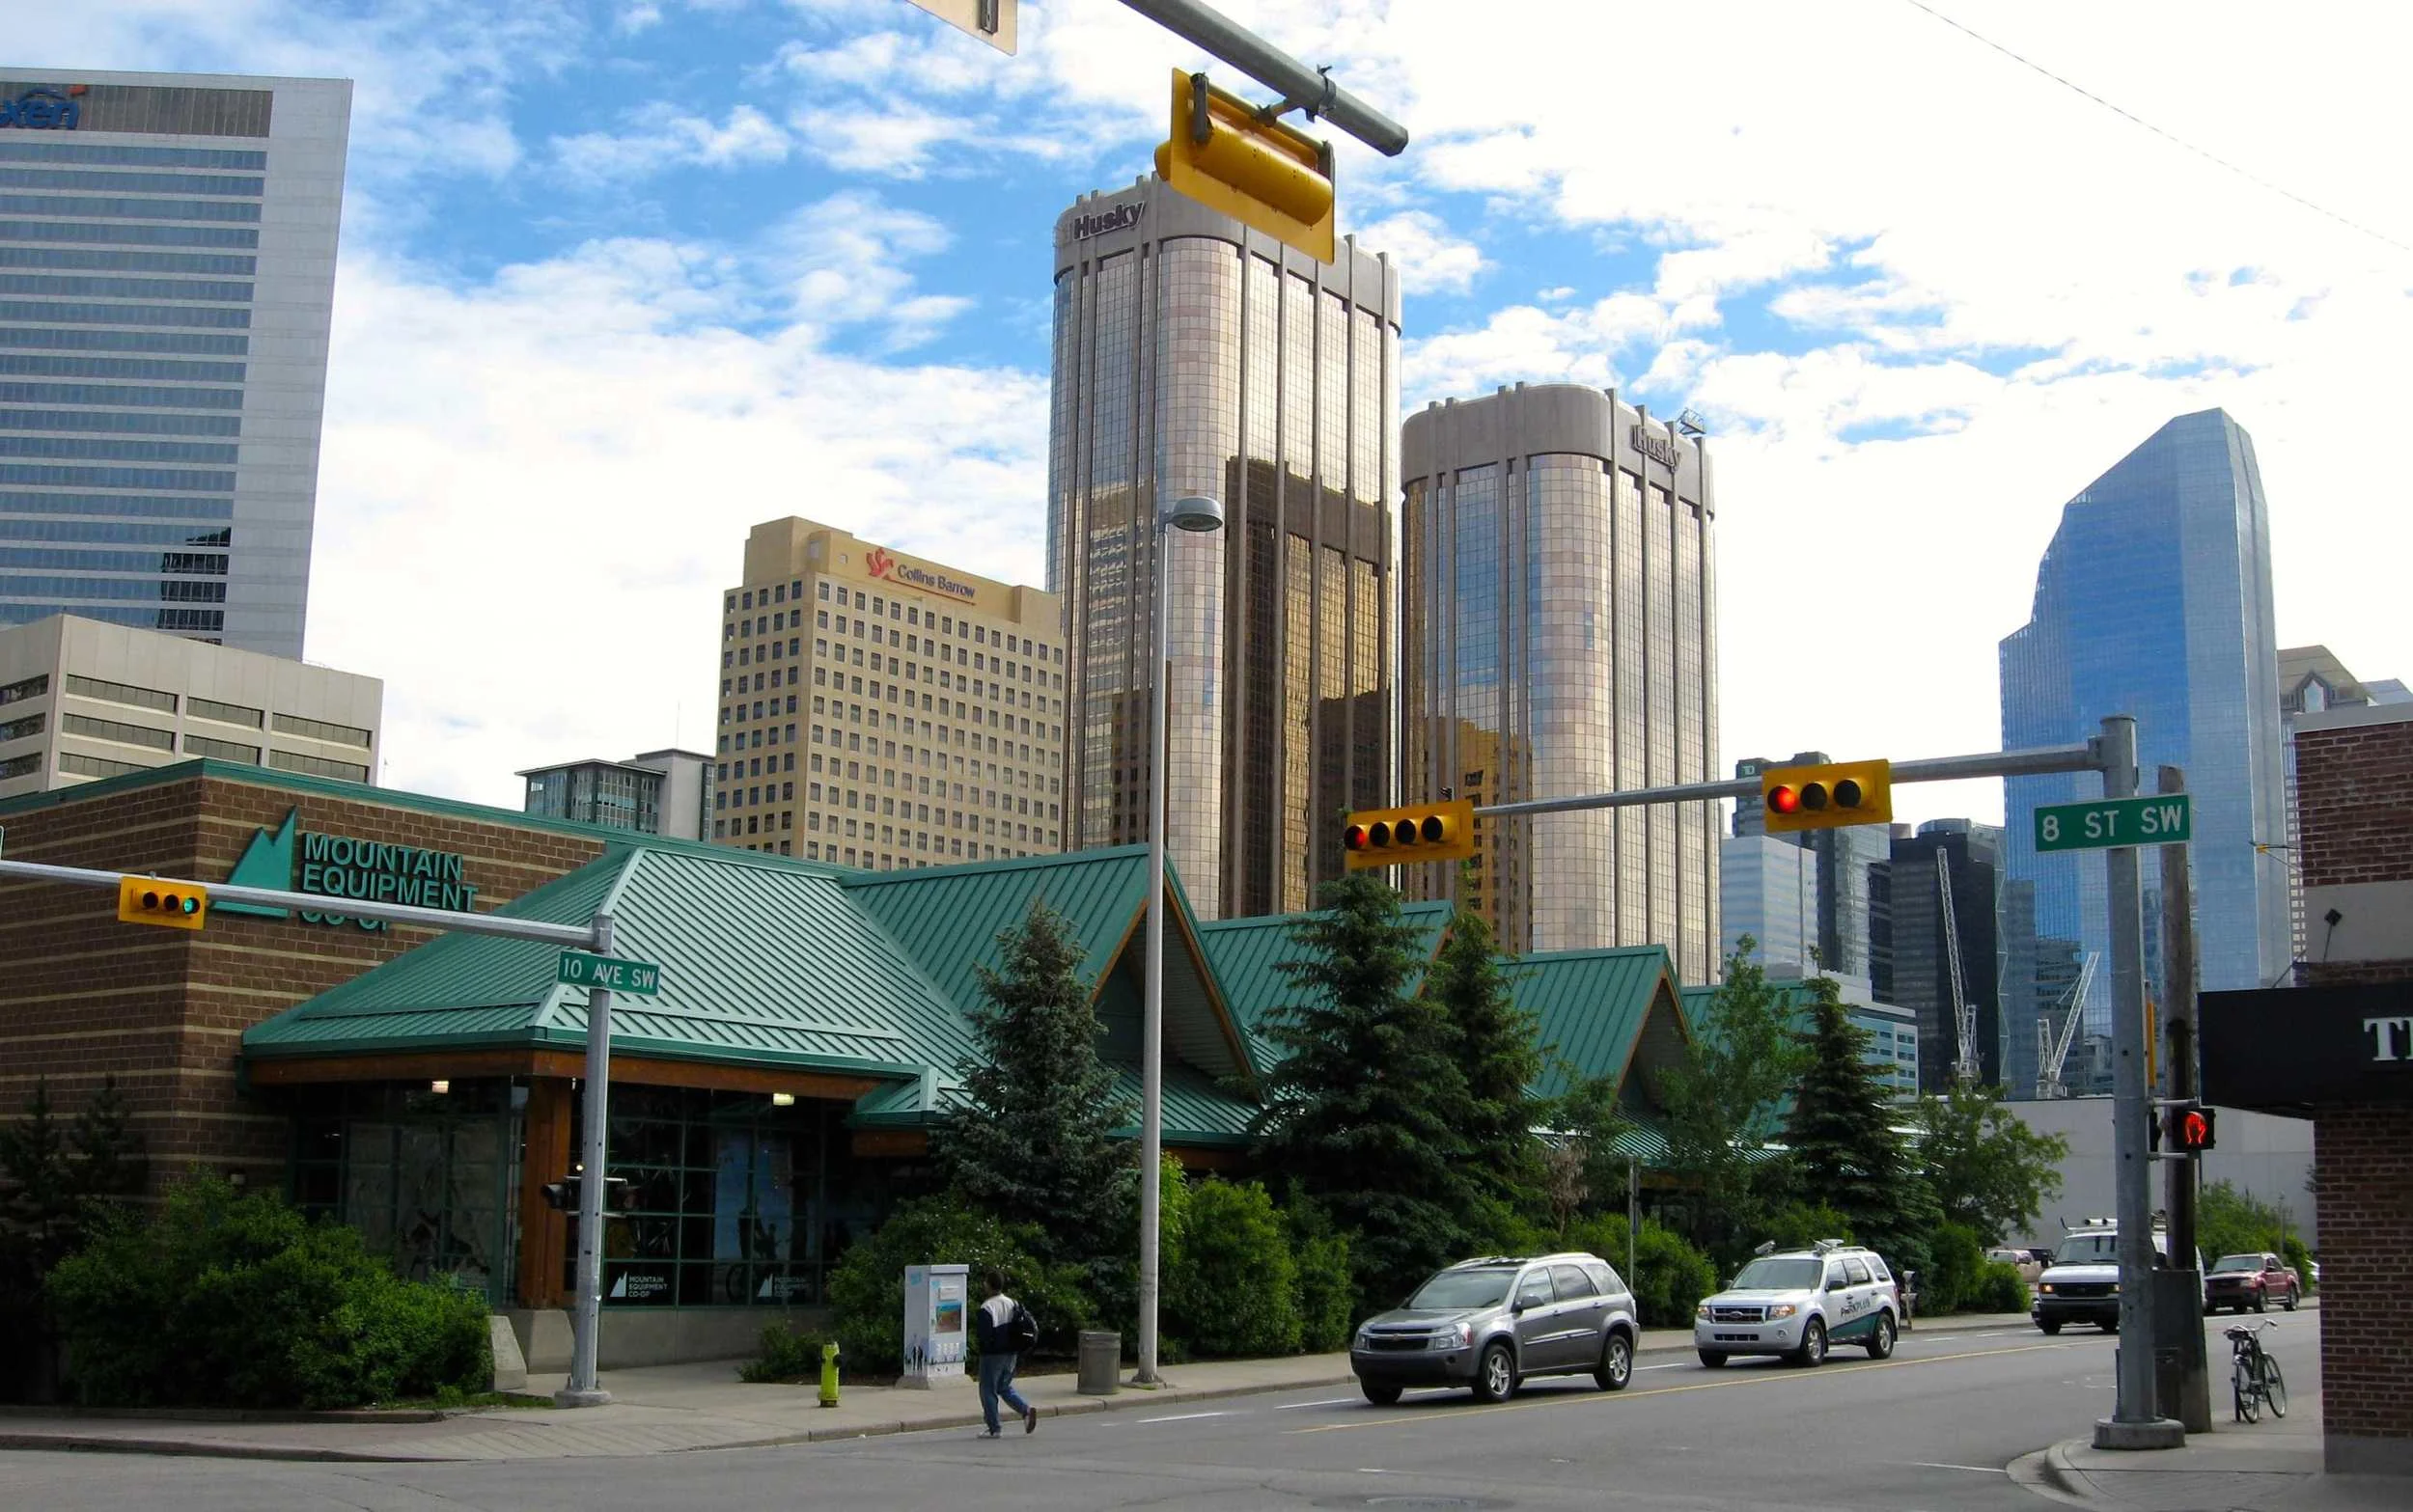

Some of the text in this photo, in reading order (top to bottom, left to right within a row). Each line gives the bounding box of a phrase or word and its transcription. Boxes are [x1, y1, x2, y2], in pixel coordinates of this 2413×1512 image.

[1074, 203, 1144, 239] Husky
[1632, 425, 1681, 472] Husky
[898, 564, 975, 598] Collins Barrow
[2042, 805, 2182, 841] 8 ST SW
[304, 833, 463, 880] MOUNTAIN
[303, 863, 479, 912] EQUIPMENT
[564, 958, 656, 989] 10 AVE SW
[2363, 1016, 2413, 1061] T
